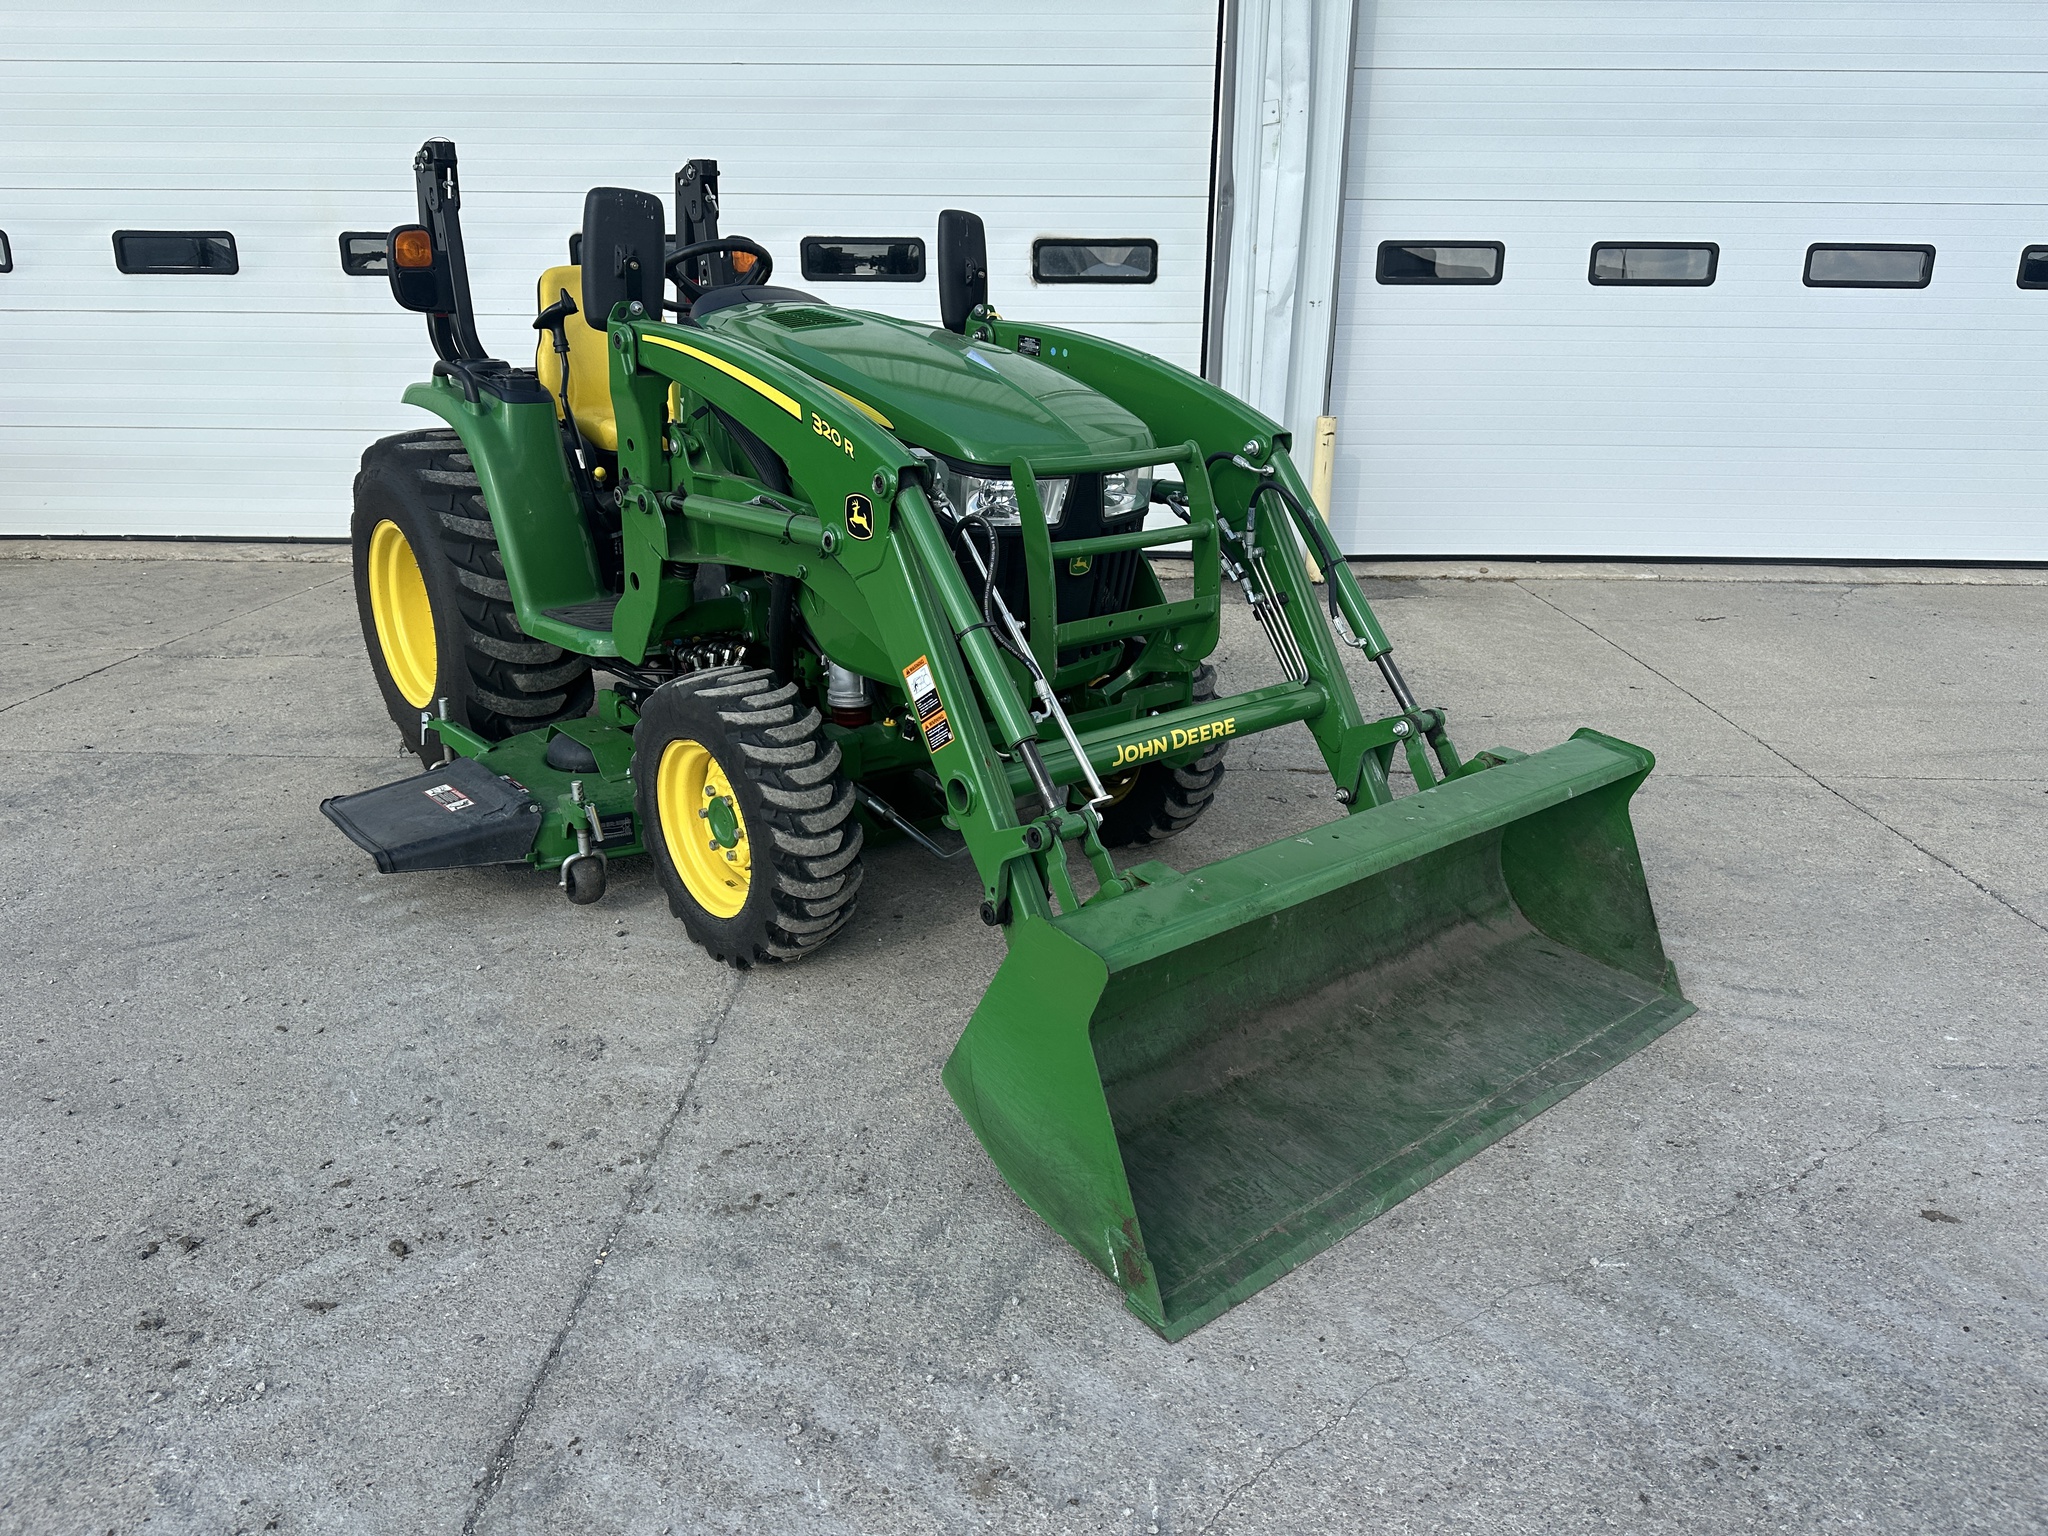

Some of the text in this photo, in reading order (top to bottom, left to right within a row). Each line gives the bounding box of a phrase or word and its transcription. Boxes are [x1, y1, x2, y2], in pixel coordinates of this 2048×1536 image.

[811, 412, 855, 459] 320 R
[1112, 717, 1237, 767] JOHN DEERE
